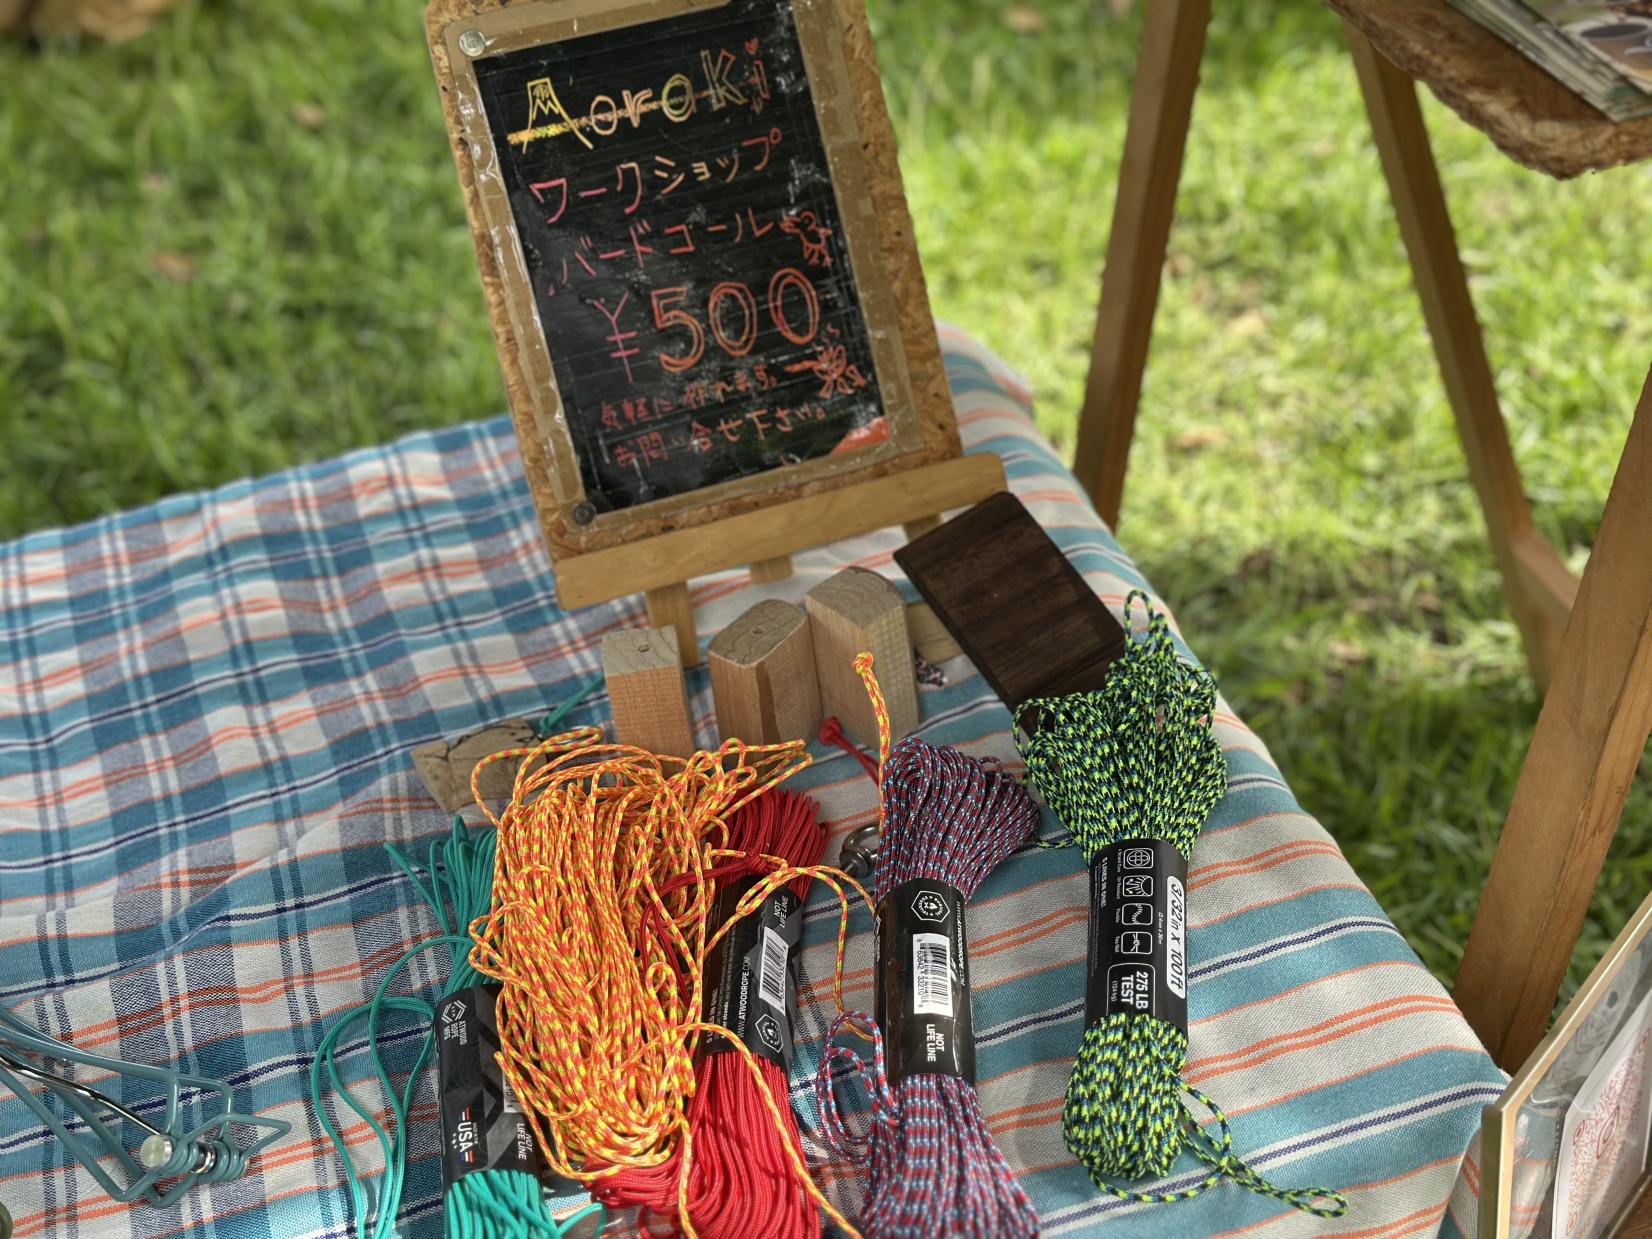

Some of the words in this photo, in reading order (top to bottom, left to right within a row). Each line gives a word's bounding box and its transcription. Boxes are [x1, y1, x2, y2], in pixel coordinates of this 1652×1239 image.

[530, 128, 782, 224] ワークショップ
[549, 208, 774, 295] バードコール
[773, 900, 781, 917] NOT
[780, 895, 789, 912] LINE
[780, 912, 788, 928] LIFE
[1120, 974, 1134, 1005] TEST
[1136, 970, 1148, 992] 275
[738, 956, 752, 1038] WWW.ATWOODROPE.COM
[1136, 994, 1148, 1010] LB
[450, 1022, 459, 1039] ROPE
[458, 1020, 467, 1045] ATWOOD
[926, 1024, 936, 1042] LIFE
[936, 1032, 944, 1052] NOT
[926, 1043, 936, 1062] LINE
[458, 1121, 473, 1152] USA
[517, 1123, 526, 1141] LIFE
[518, 1141, 527, 1160] LINE
[525, 1133, 533, 1152] NOT
